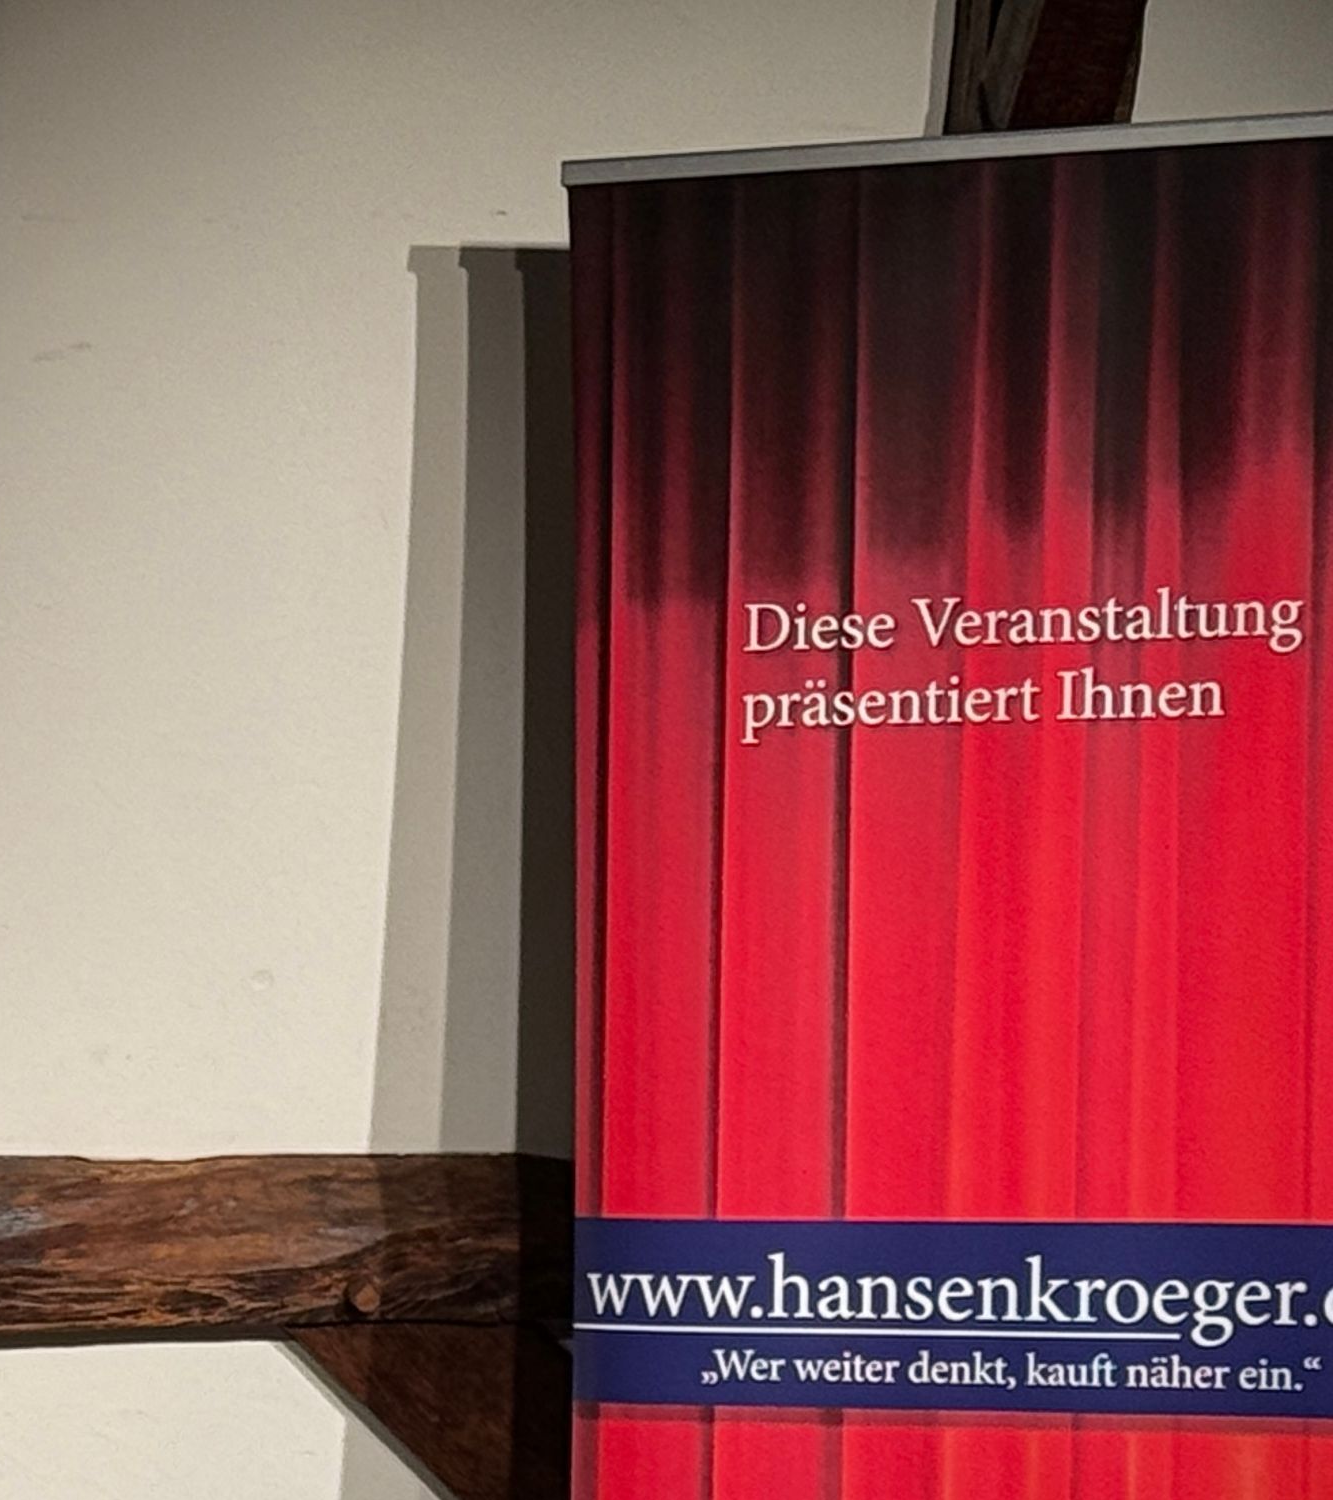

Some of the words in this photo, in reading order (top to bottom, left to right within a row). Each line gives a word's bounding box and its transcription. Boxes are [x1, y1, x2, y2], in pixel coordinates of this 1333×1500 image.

[743, 603, 896, 652] Diese
[911, 587, 1303, 653] Veranstaltung
[741, 676, 1041, 744] präsentiert
[1055, 667, 1225, 720] Ihnen
[587, 1253, 1333, 1347] www.hansenkroeger.
[701, 1349, 787, 1385] „Wer
[794, 1351, 900, 1383] weiter
[908, 1352, 1017, 1388] denkt,
[1027, 1353, 1117, 1388] kauft
[1126, 1354, 1231, 1389] näher
